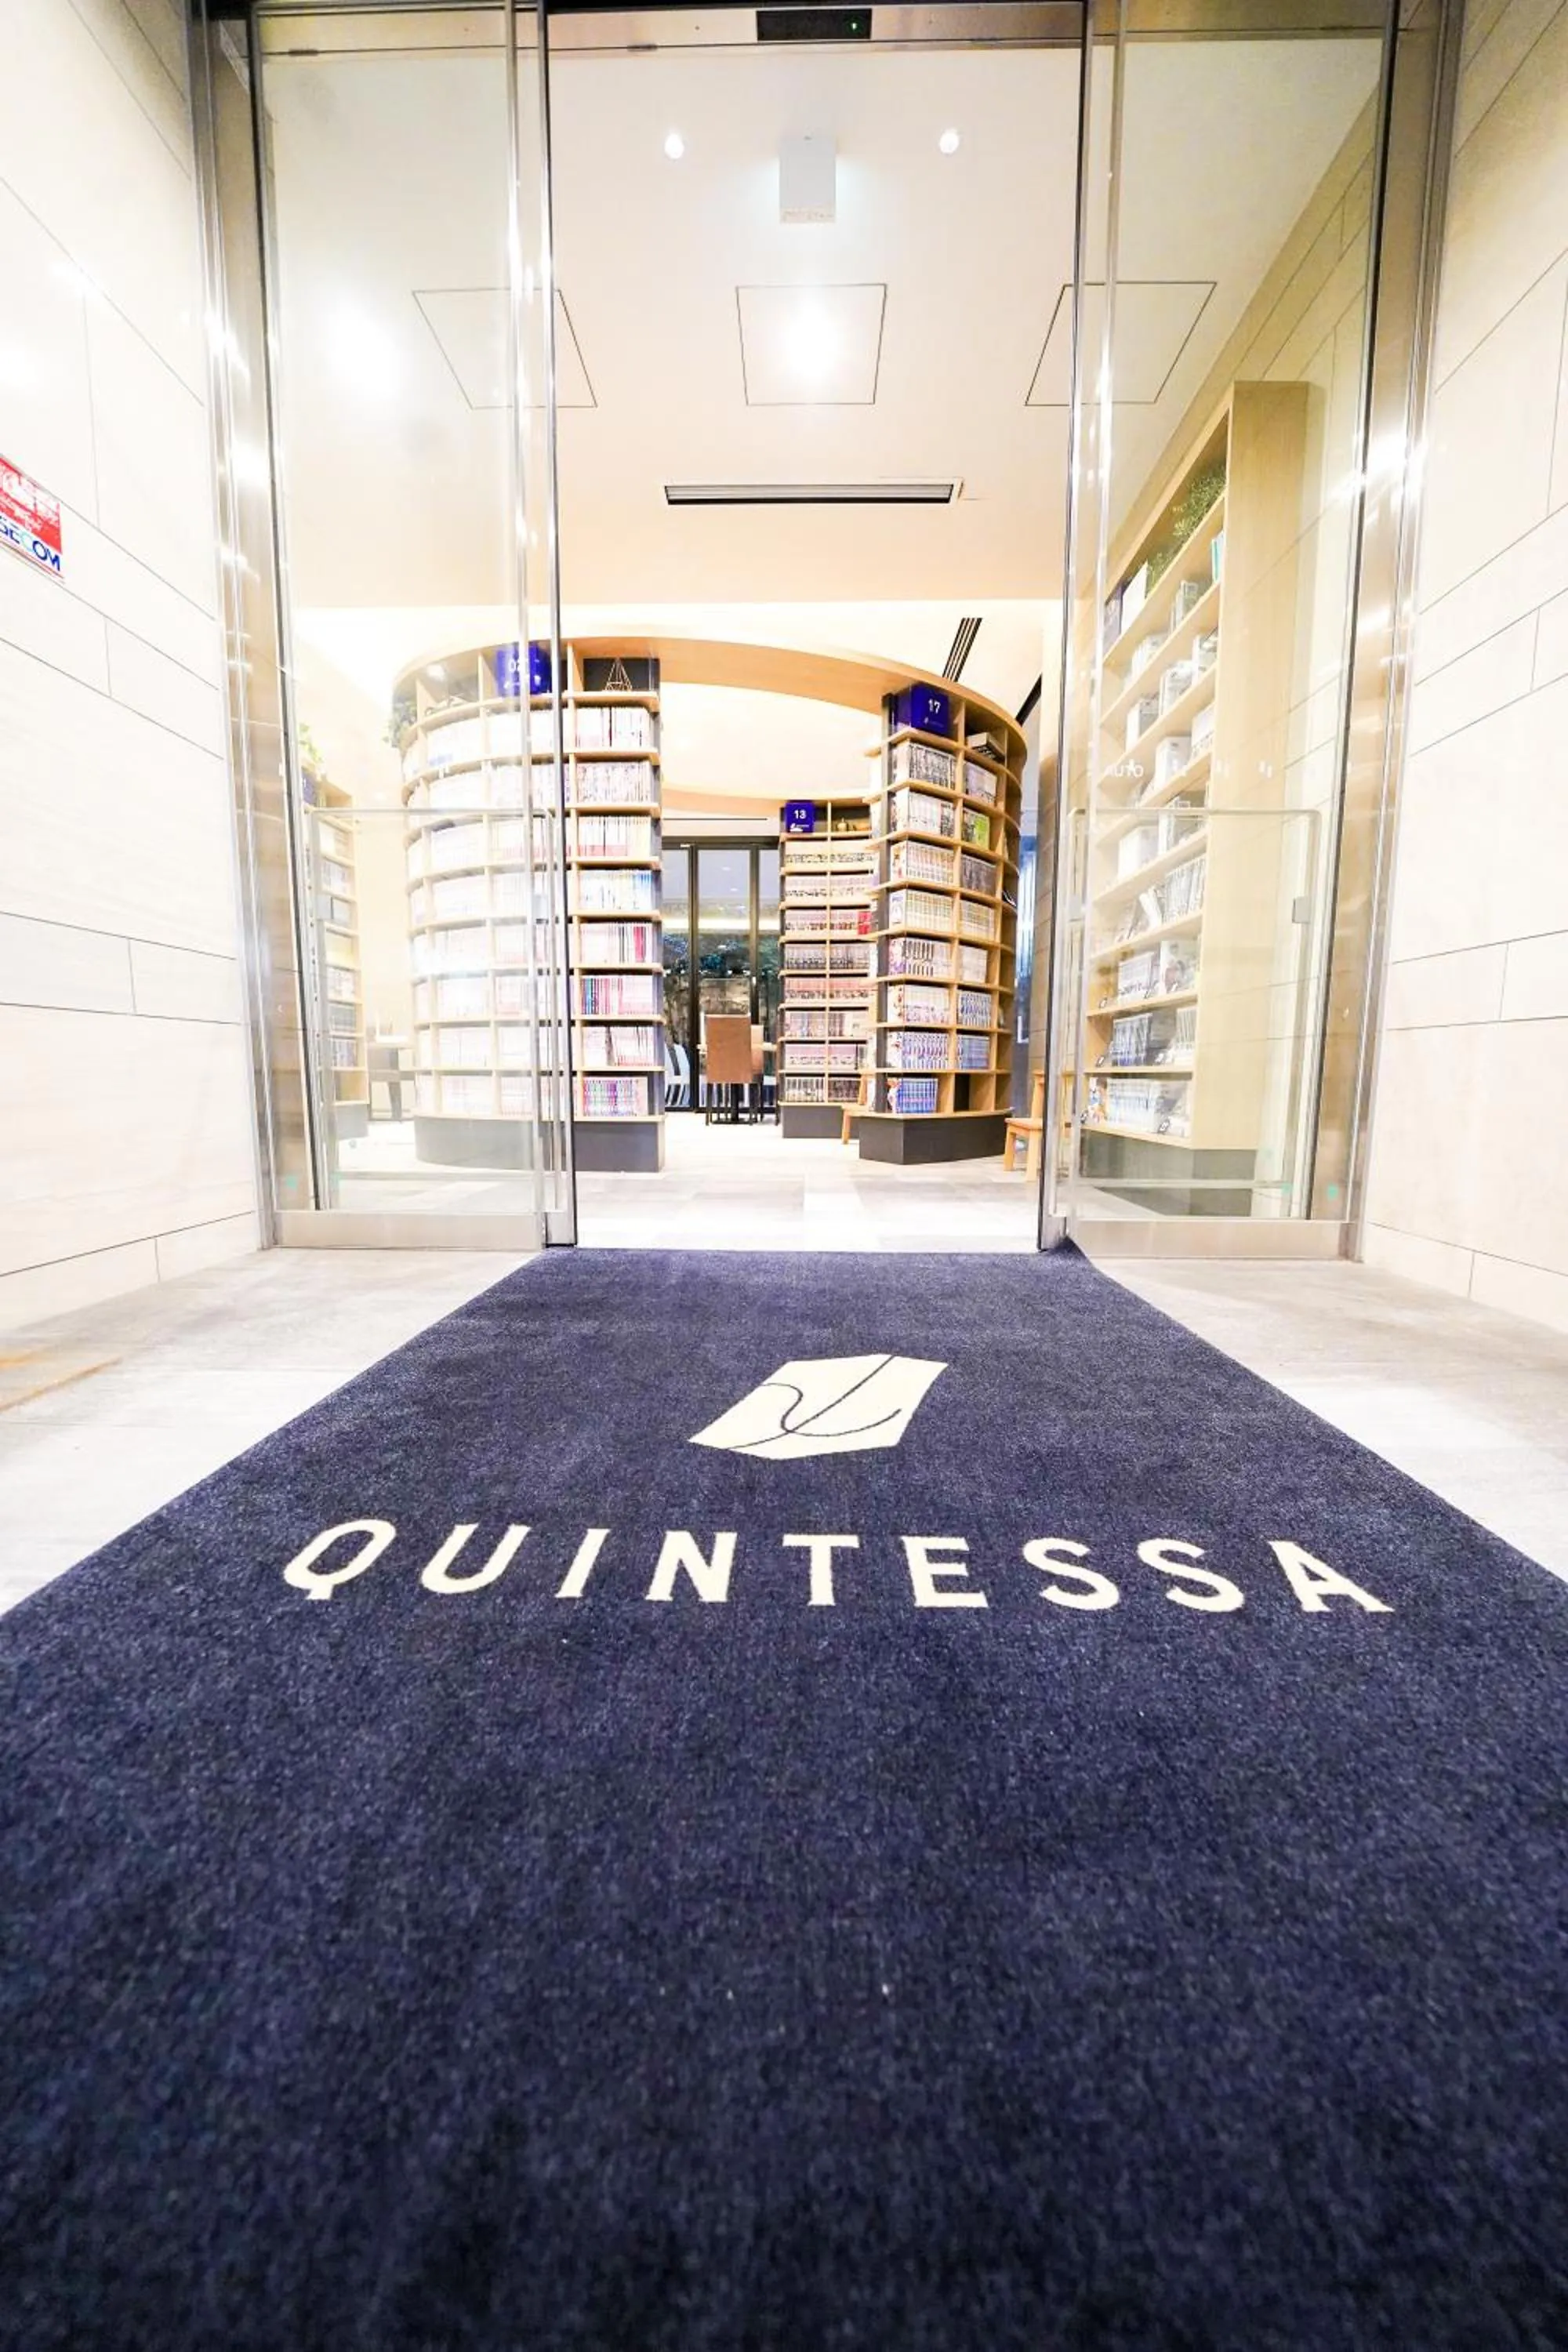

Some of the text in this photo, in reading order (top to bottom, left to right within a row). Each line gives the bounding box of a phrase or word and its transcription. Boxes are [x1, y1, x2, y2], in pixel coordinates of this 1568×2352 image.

[927, 699, 941, 713] 17
[793, 809, 807, 819] 13
[282, 1519, 1396, 1613] QUINTESSA
